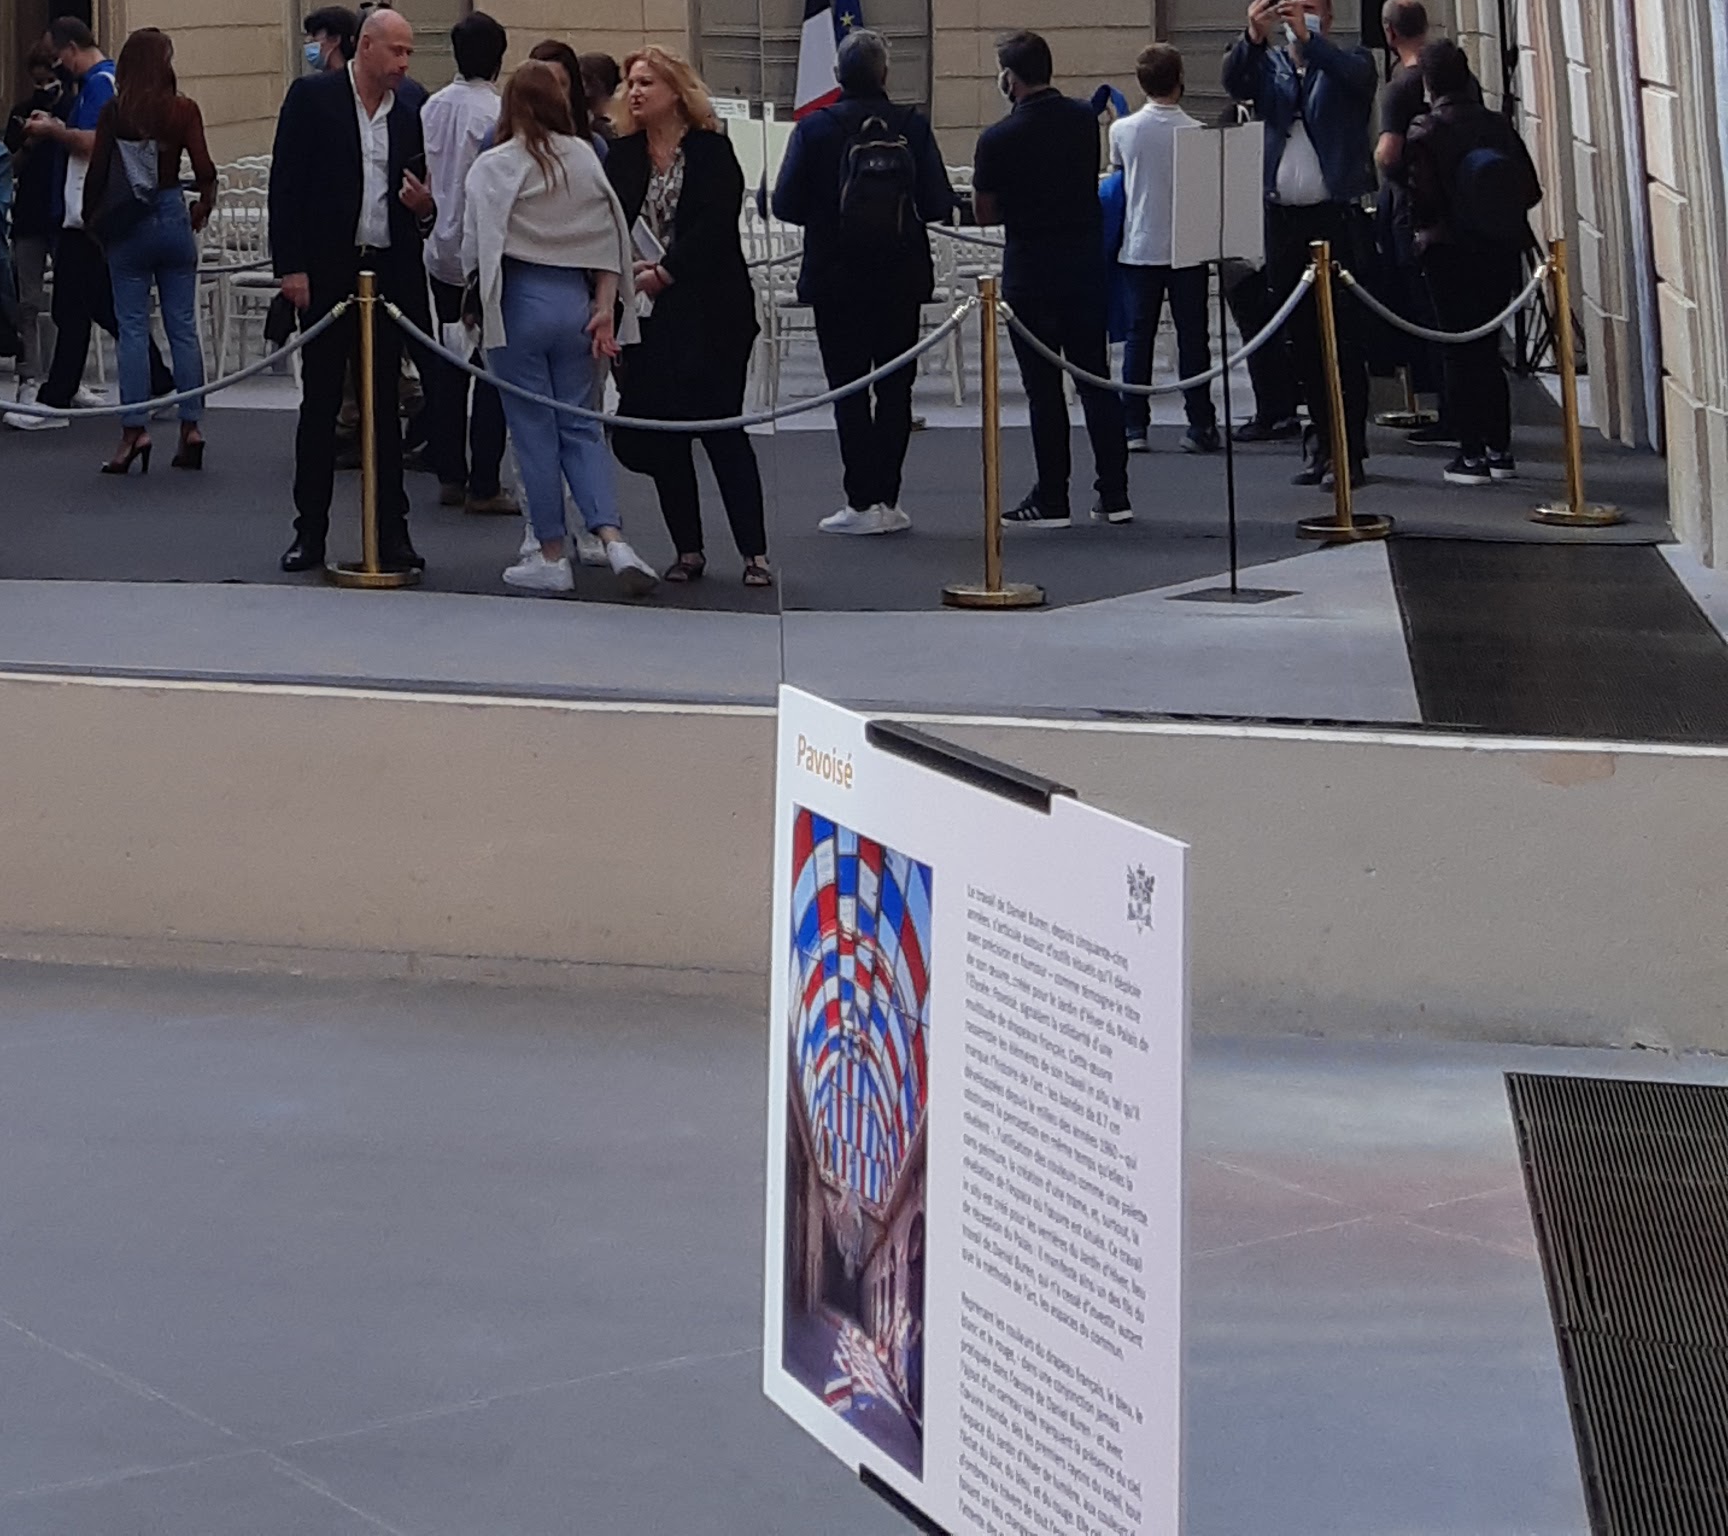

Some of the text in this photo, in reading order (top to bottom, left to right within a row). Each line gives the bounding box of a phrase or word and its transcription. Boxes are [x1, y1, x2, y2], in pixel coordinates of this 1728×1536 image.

[797, 734, 852, 789] Pavoisé
[976, 890, 996, 907] travail
[1007, 902, 1027, 922] Daniel
[1065, 1072, 1086, 1092] travail
[962, 1224, 982, 1244] travail
[993, 1242, 1013, 1265] Daniel
[1120, 1249, 1142, 1271] travail
[1047, 1397, 1068, 1422] Daniel
